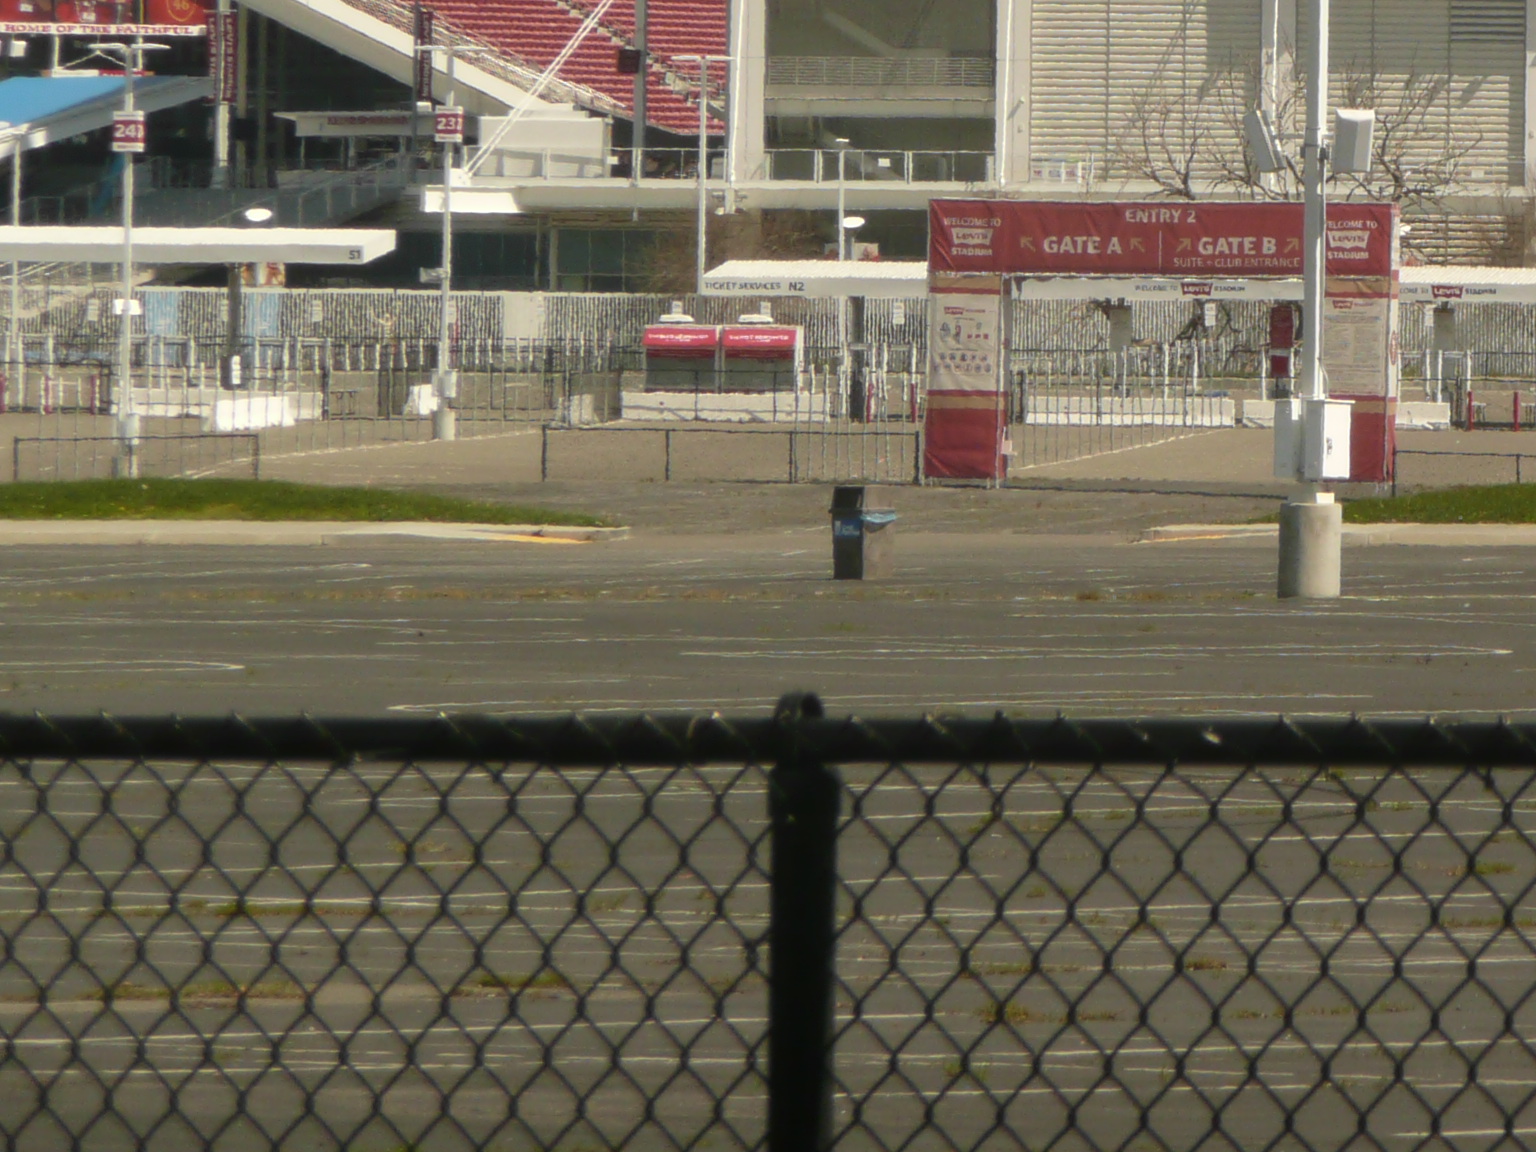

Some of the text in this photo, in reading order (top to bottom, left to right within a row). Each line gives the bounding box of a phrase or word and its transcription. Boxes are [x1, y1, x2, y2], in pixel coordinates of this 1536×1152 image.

[5, 24, 194, 35] HOME OF THE FAITHFUL
[1125, 209, 1197, 223] ENTRY 2
[944, 217, 1001, 227] WELCOME TO
[1366, 221, 1378, 229] TO
[1043, 236, 1123, 254] GATE A
[1198, 237, 1277, 255] GATE B
[951, 247, 993, 256] STADIUM
[1327, 251, 1369, 259] STADIUM
[1174, 257, 1204, 268] SUITE
[1214, 258, 1242, 268] CLUB
[1244, 258, 1300, 268] ENTRANCE
[705, 281, 804, 291] TICKET SERVICES N2
